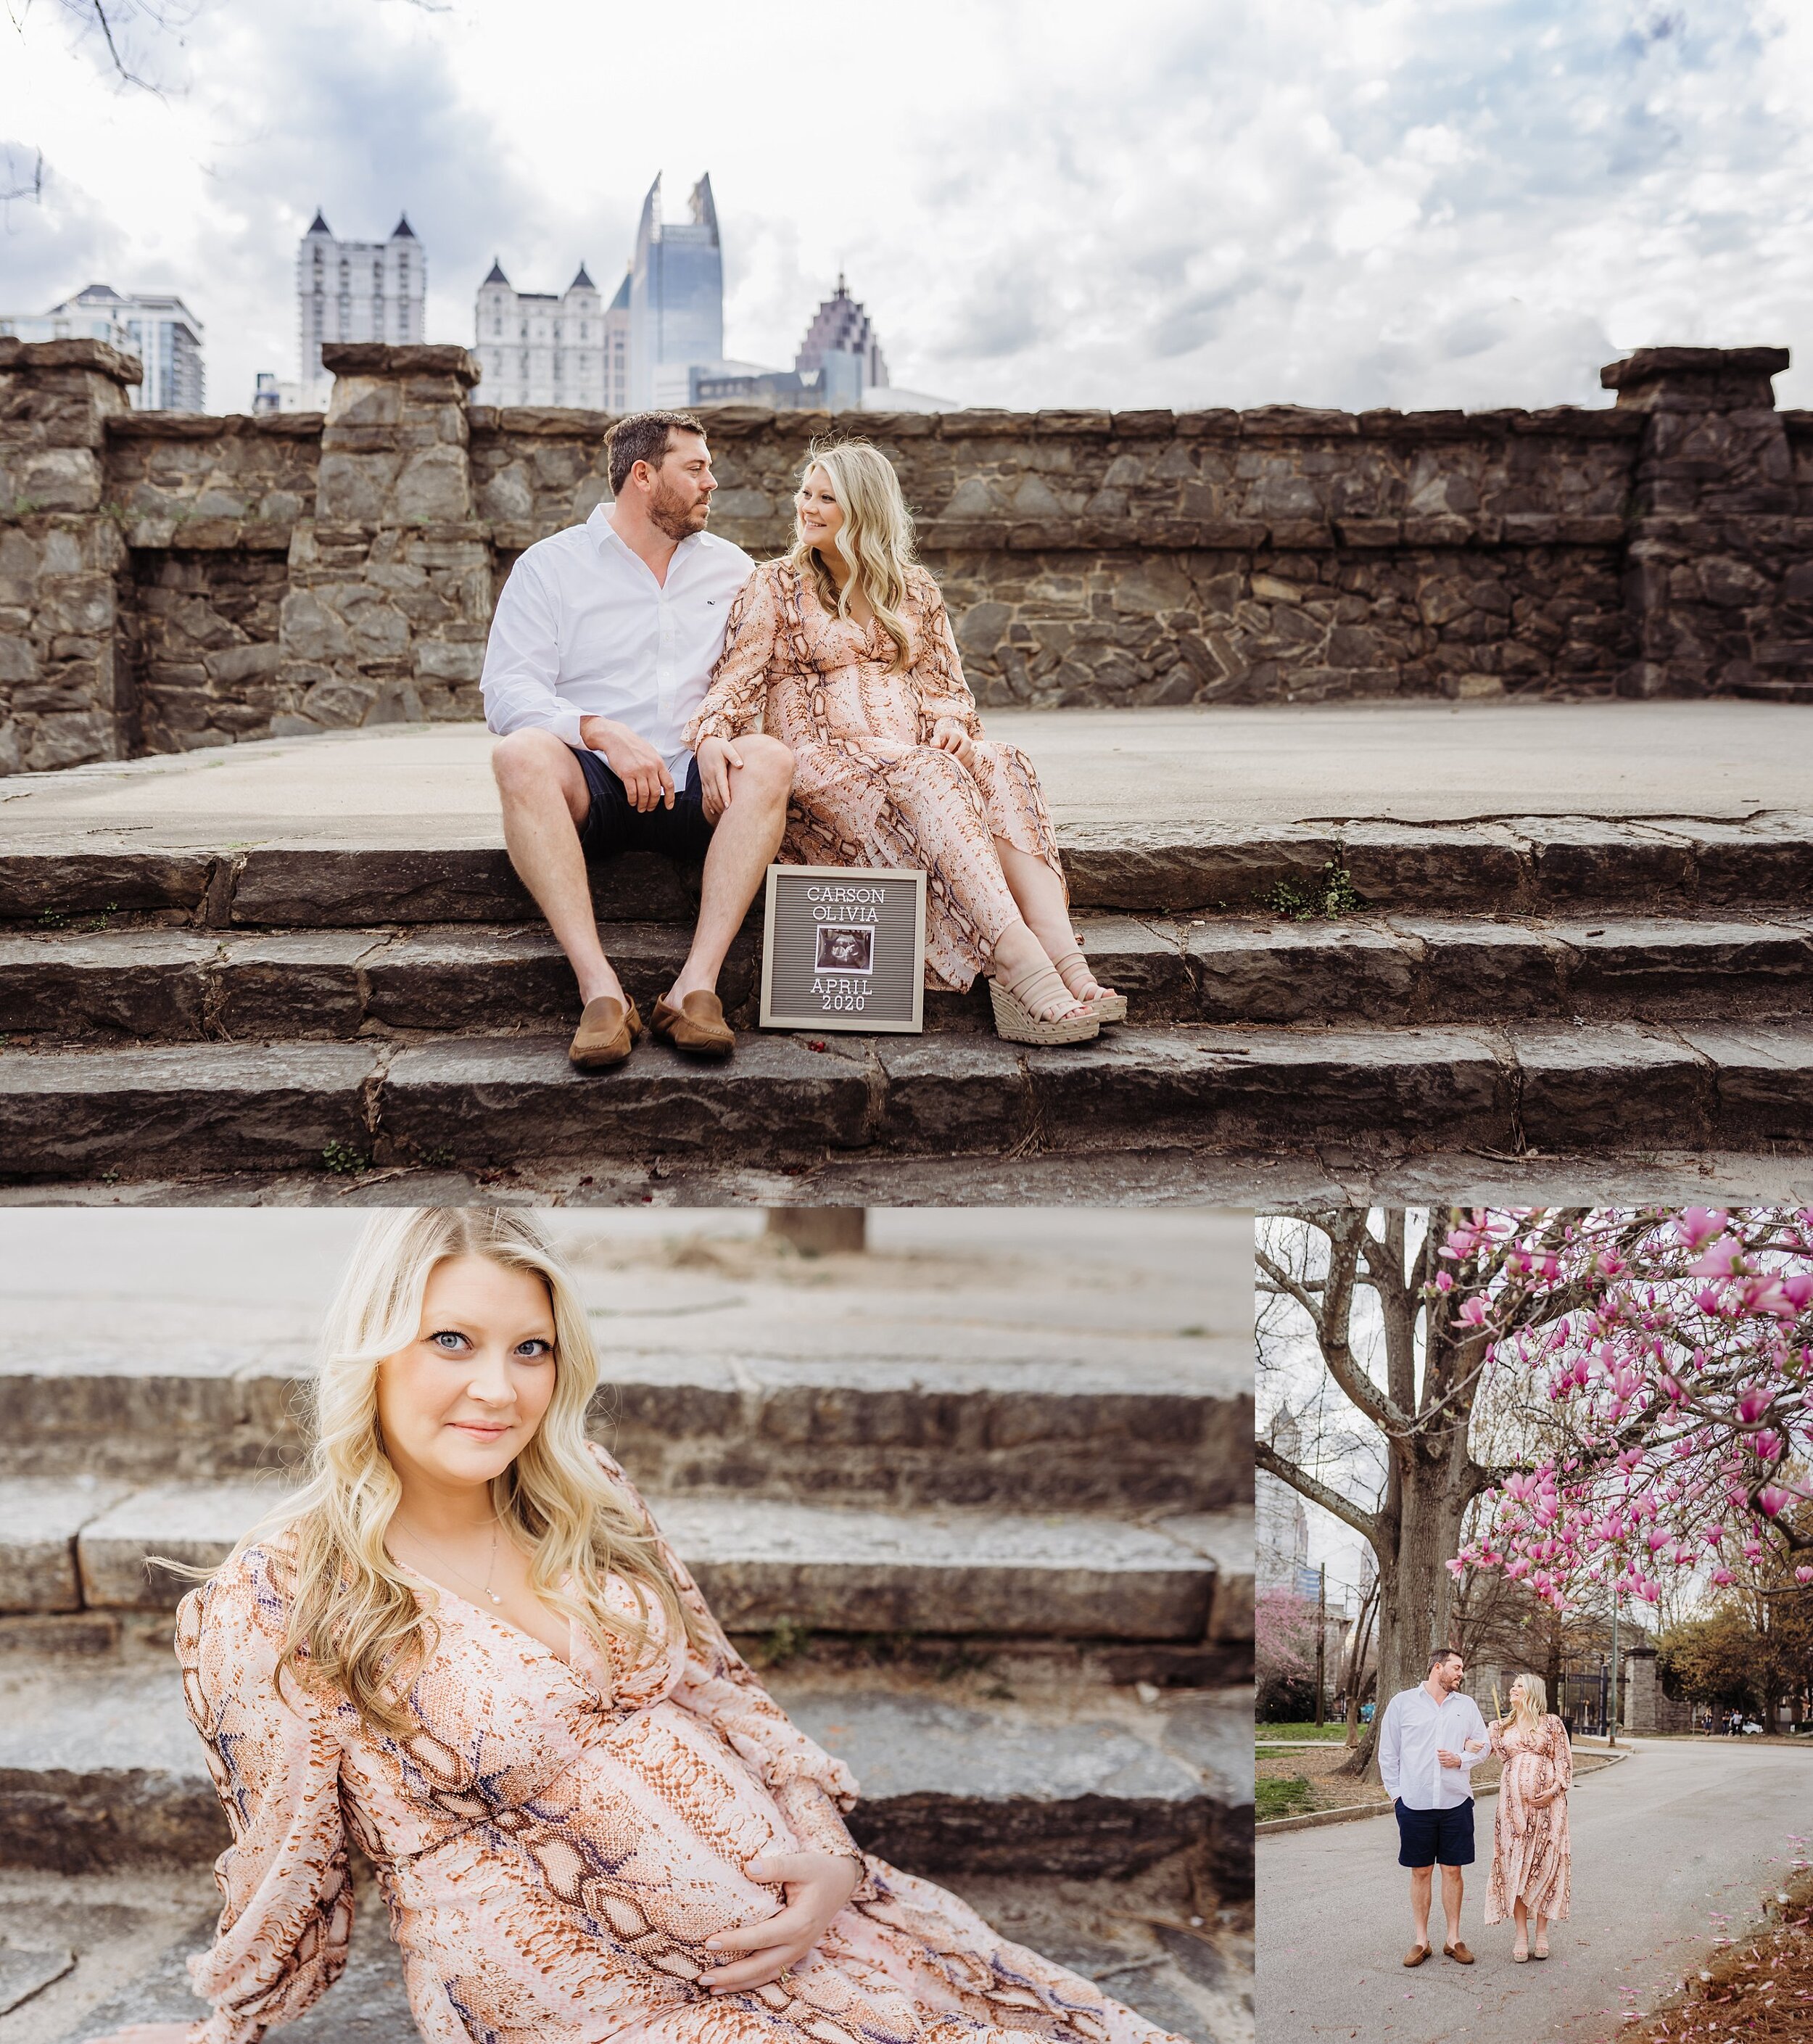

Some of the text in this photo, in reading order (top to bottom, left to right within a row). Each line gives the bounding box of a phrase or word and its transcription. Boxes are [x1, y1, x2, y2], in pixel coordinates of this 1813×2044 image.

[807, 887, 885, 904] CARSON
[812, 906, 879, 922] OLIVIA
[810, 978, 872, 995] APRIL
[822, 994, 865, 1011] 2020
